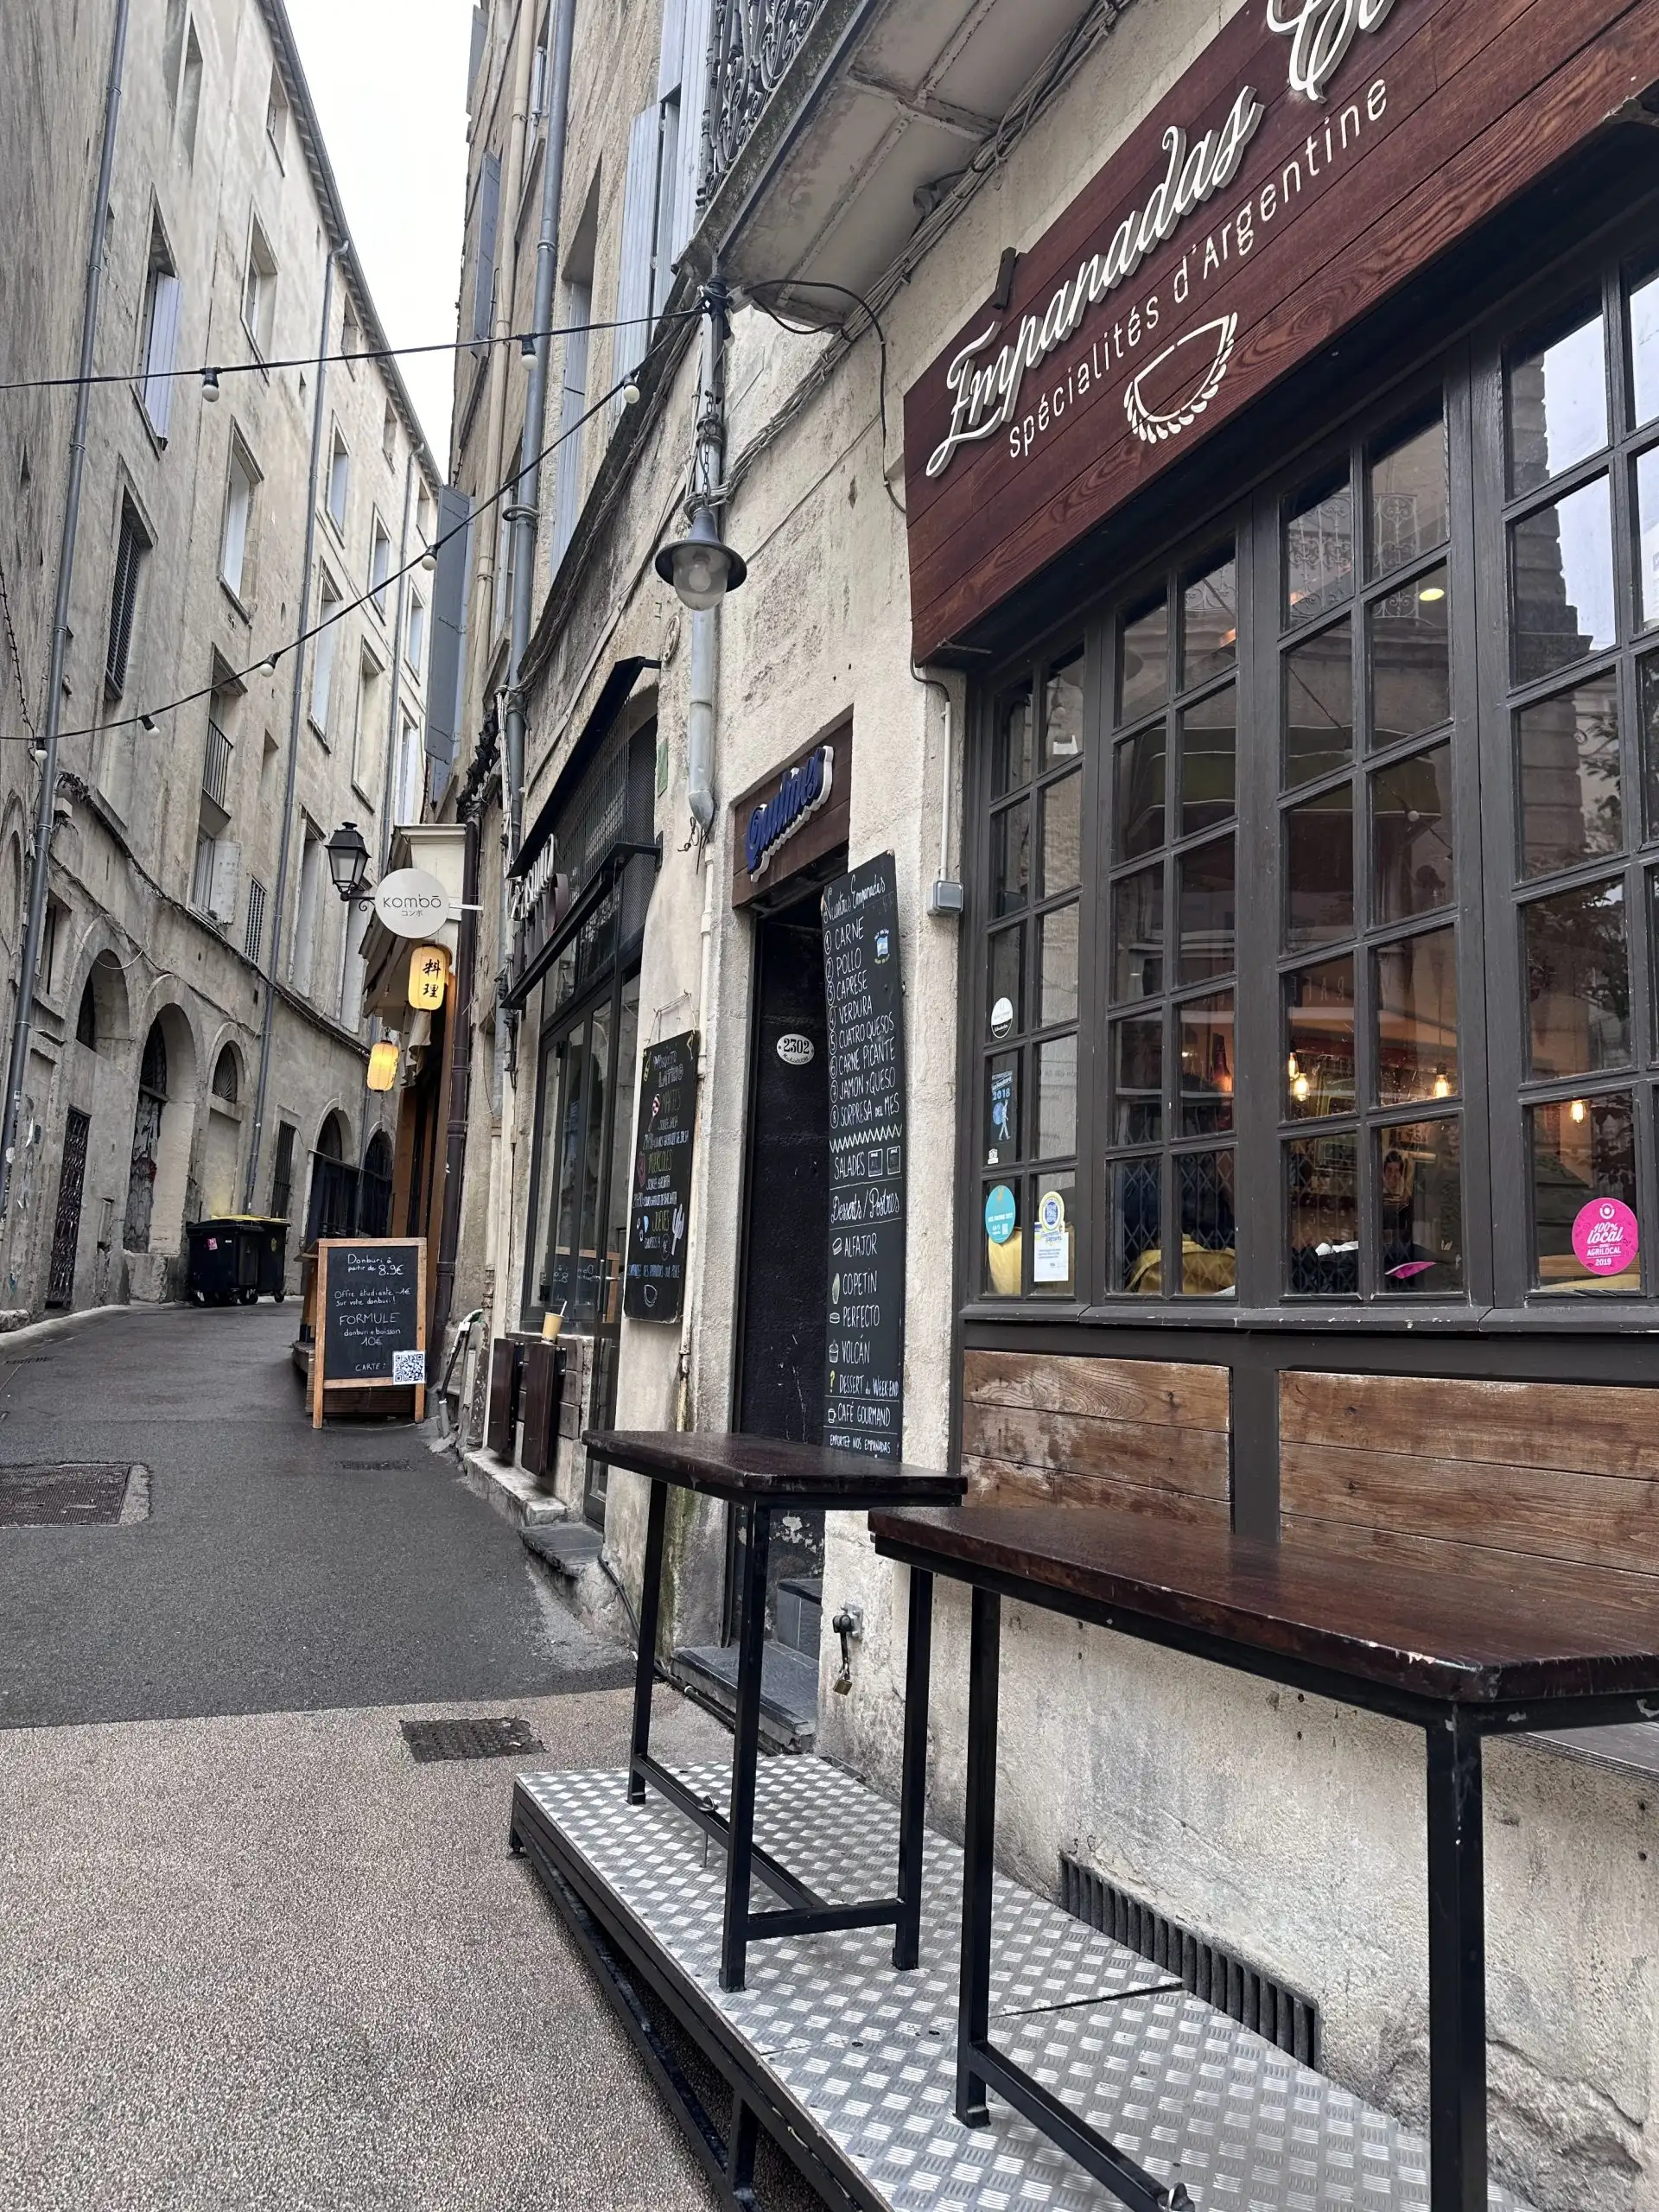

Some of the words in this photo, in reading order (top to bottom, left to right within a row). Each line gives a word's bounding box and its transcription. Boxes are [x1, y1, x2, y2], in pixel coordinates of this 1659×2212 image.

[1009, 296, 1159, 457] spécialités
[1173, 79, 1387, 303] d'Argentine
[926, 85, 1262, 476] Empanadas
[835, 916, 864, 950] CARNE
[836, 947, 861, 977] POLLO
[423, 958, 442, 998] 料理
[836, 969, 868, 1001] CAPRESE
[839, 995, 873, 1024] VERDURA
[838, 1024, 865, 1049] CUATRO
[867, 1012, 894, 1040] QUESOS
[783, 1038, 810, 1055] 2302
[838, 1048, 861, 1075] CARNE
[839, 1074, 864, 1100] JAMON
[869, 1067, 896, 1096] QUESO
[992, 1087, 1011, 1101] 2018
[840, 1099, 873, 1127] SORPRESA
[884, 1092, 899, 1116] MES
[834, 1151, 865, 1180] SALADES
[1587, 1226, 1624, 1244] local
[1593, 1222, 1618, 1233] 100%
[844, 1233, 878, 1257] ALFAJOR
[1586, 1247, 1621, 1256] AGRILOCAL
[347, 1254, 383, 1264] Donburi
[378, 1264, 404, 1276] 8.9€
[334, 1290, 355, 1299] Offre
[359, 1287, 394, 1297] étudiante
[340, 1313, 401, 1325] FORMULE
[843, 1305, 880, 1328] PERFECTO
[344, 1328, 369, 1337] donburi
[360, 1336, 384, 1346] 10€
[842, 1334, 870, 1364] VOLCÁN
[839, 1374, 864, 1395] DESSERT
[837, 1402, 855, 1422] CAFÉ
[857, 1405, 891, 1427] GOURMAND
[852, 1436, 862, 1450] NOS
[864, 1439, 891, 1453] EMPANADAS
